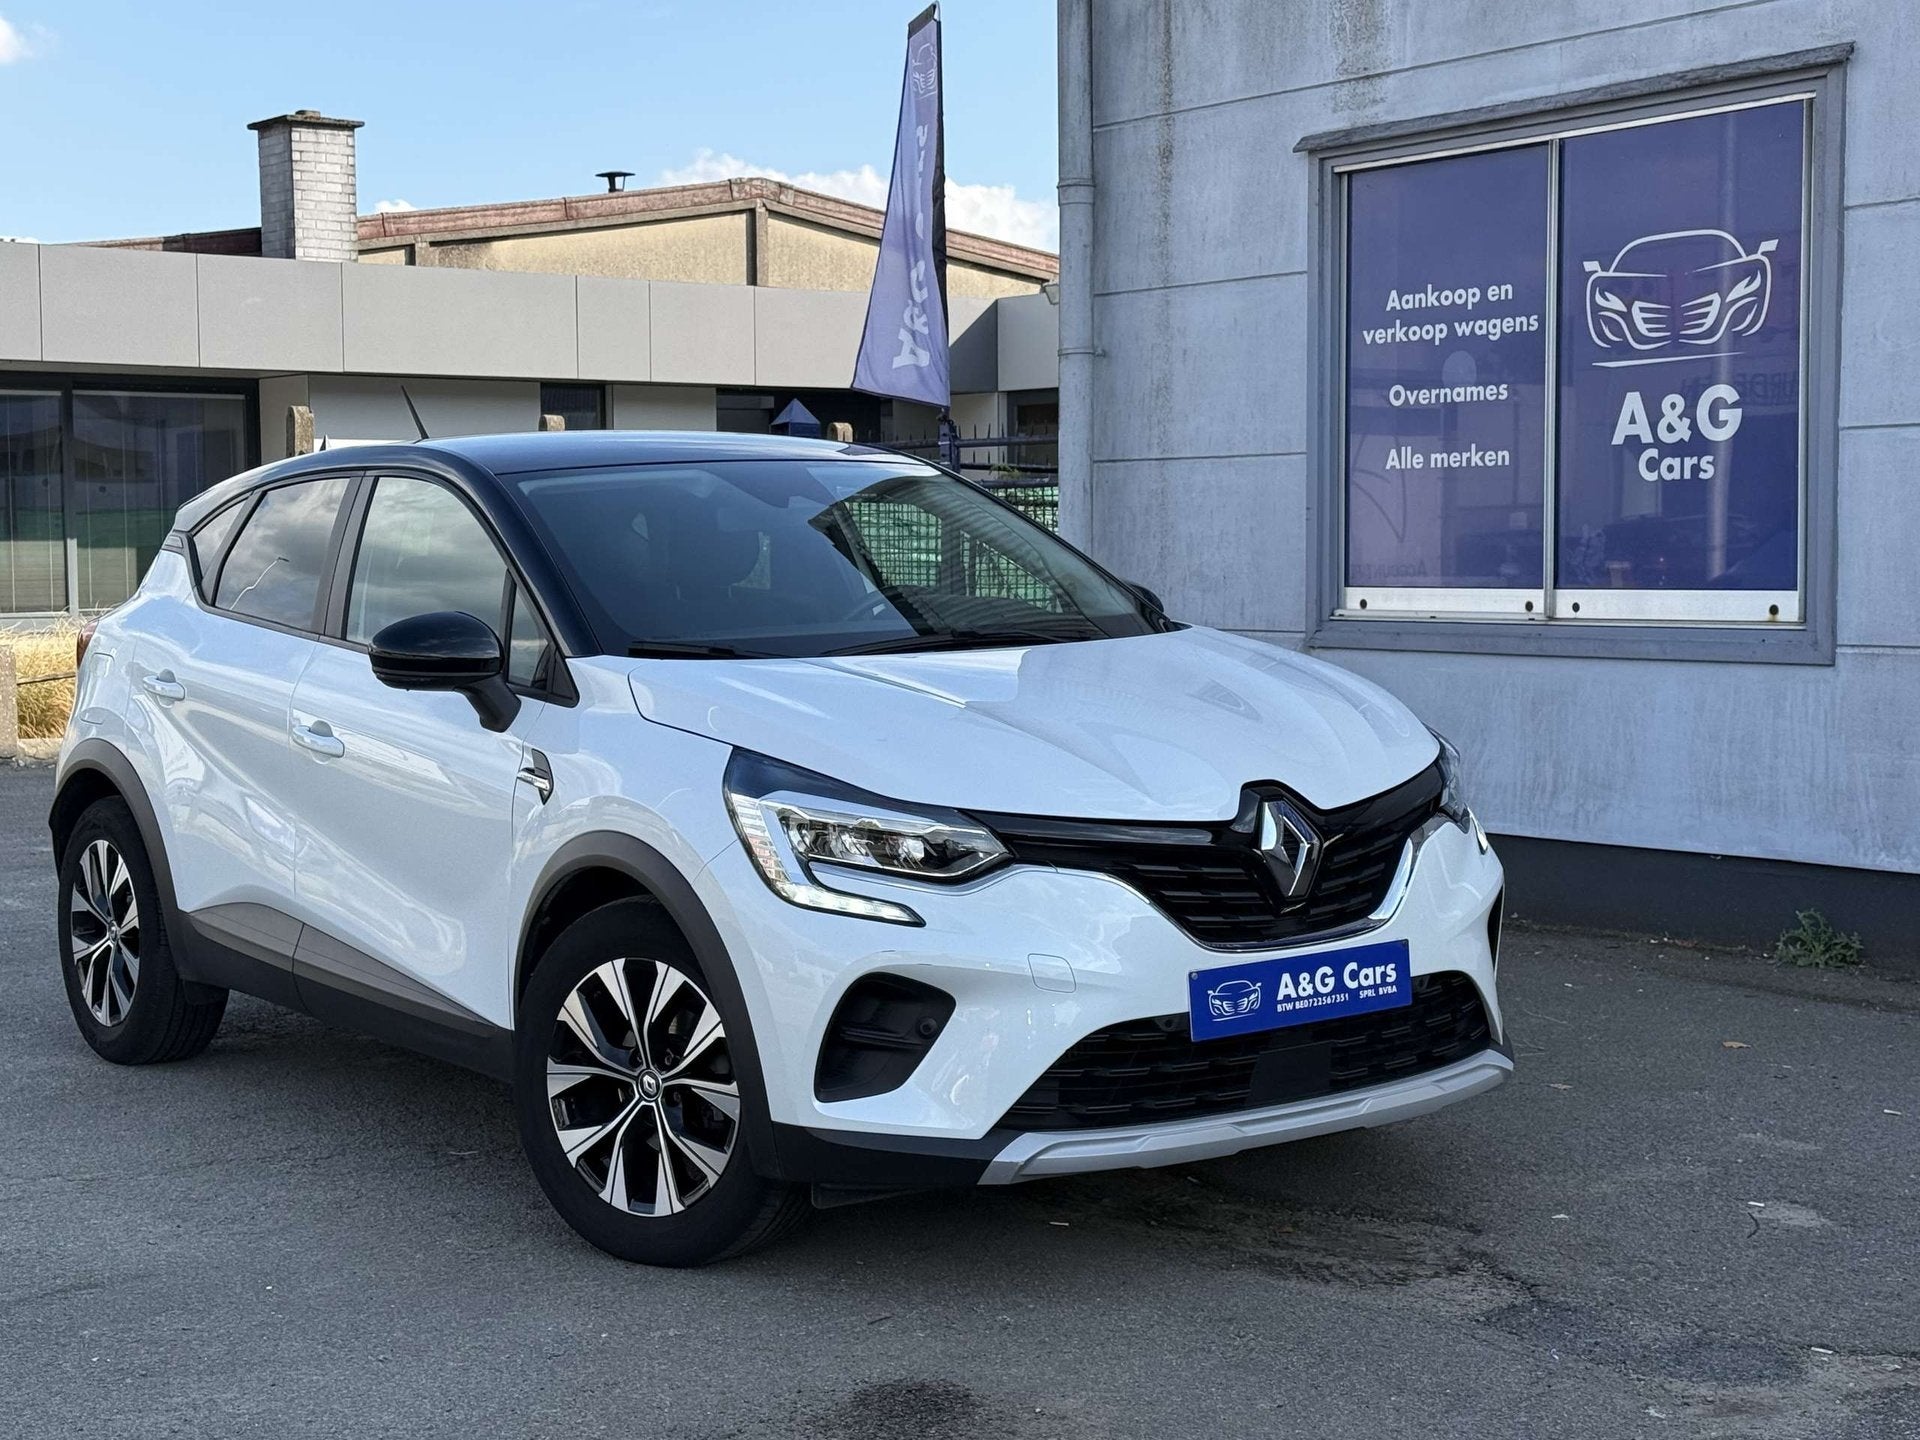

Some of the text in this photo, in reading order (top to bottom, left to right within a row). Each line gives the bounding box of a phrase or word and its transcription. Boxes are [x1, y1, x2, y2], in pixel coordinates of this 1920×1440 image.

[1386, 283, 1513, 312] Aankoop en
[1363, 314, 1539, 345] verkoop wagens
[1389, 384, 1508, 406] Overnames
[1611, 384, 1743, 445] A&G
[1385, 443, 1510, 469] Alle merken
[1638, 448, 1715, 482] Cars
[1277, 962, 1397, 1000] A&G Cars
[1277, 1002, 1293, 1012] BTW
[1359, 989, 1376, 998] SPRL
[1378, 985, 1397, 995] BVBA
